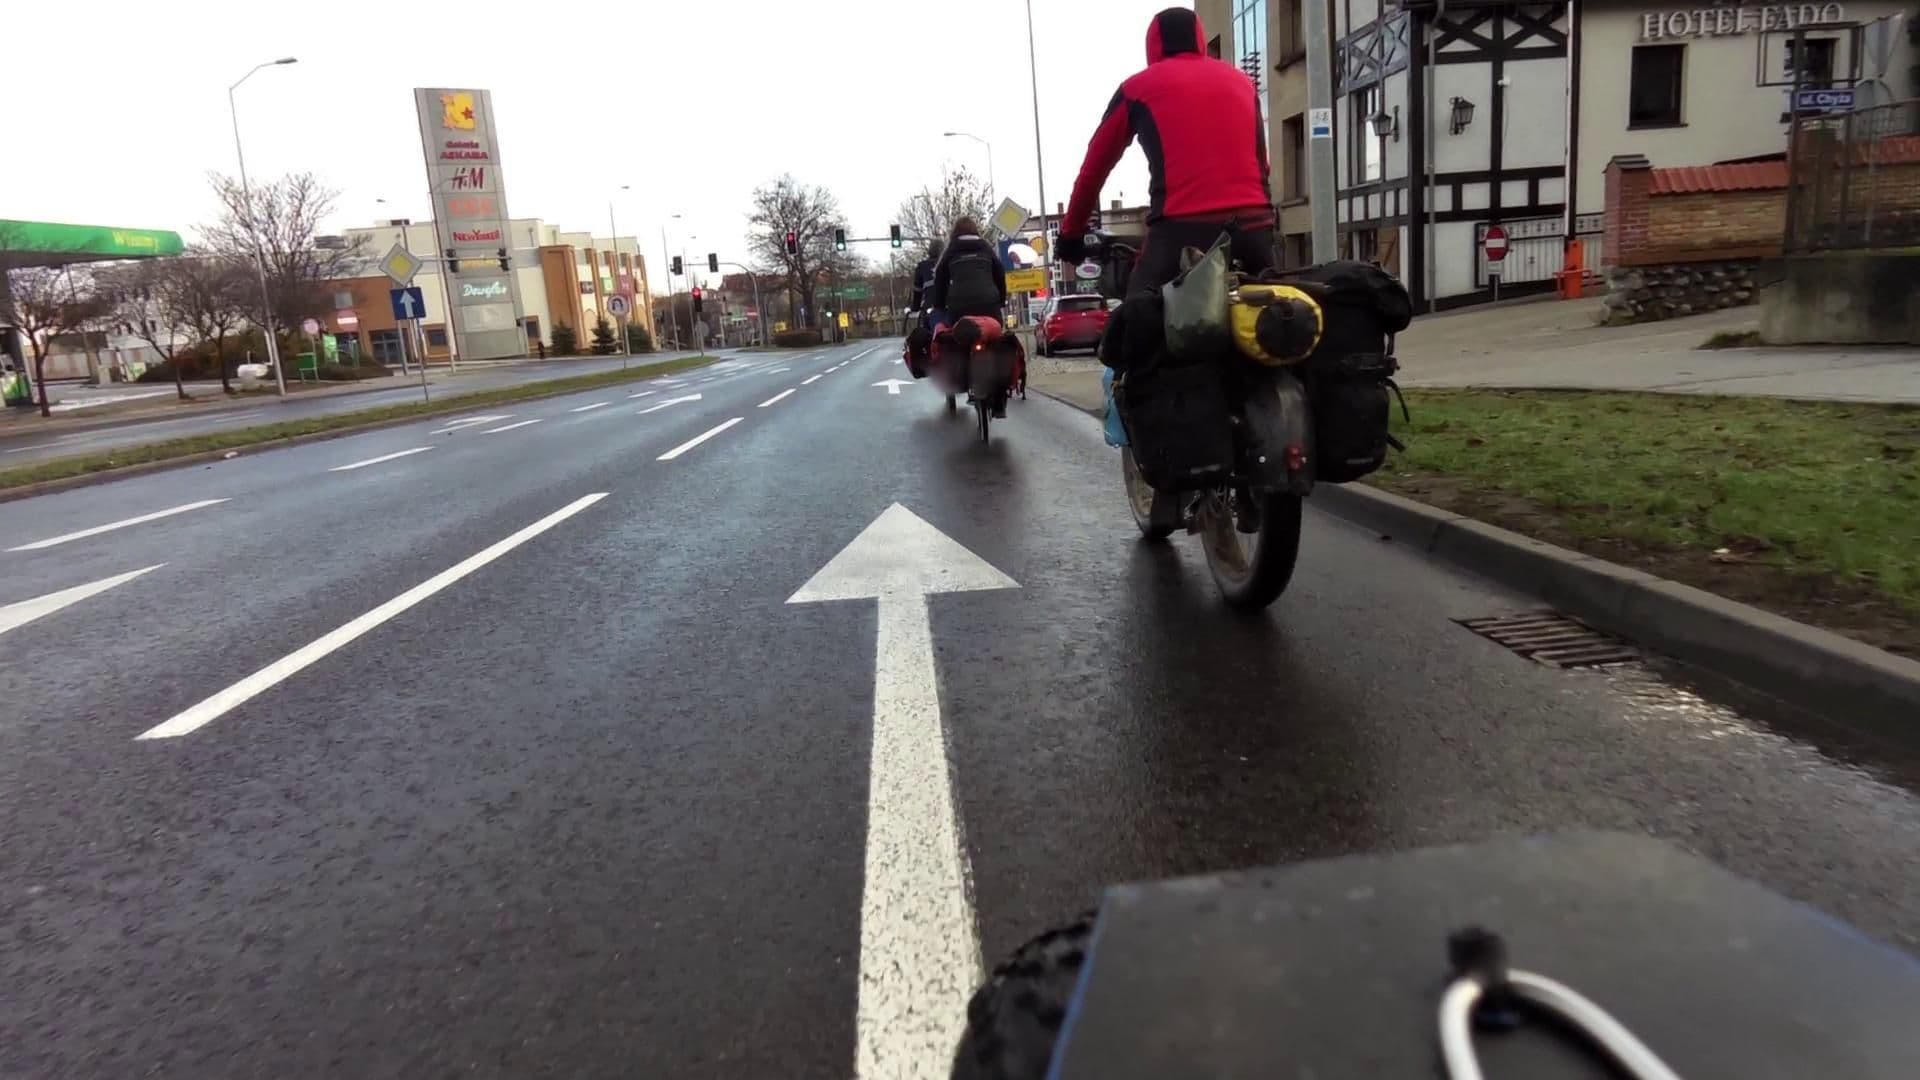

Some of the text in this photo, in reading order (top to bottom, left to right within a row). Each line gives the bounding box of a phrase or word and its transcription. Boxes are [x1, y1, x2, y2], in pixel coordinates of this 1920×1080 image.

[1643, 2, 1844, 38] HOTEL FADO
[450, 168, 483, 189] H&M
